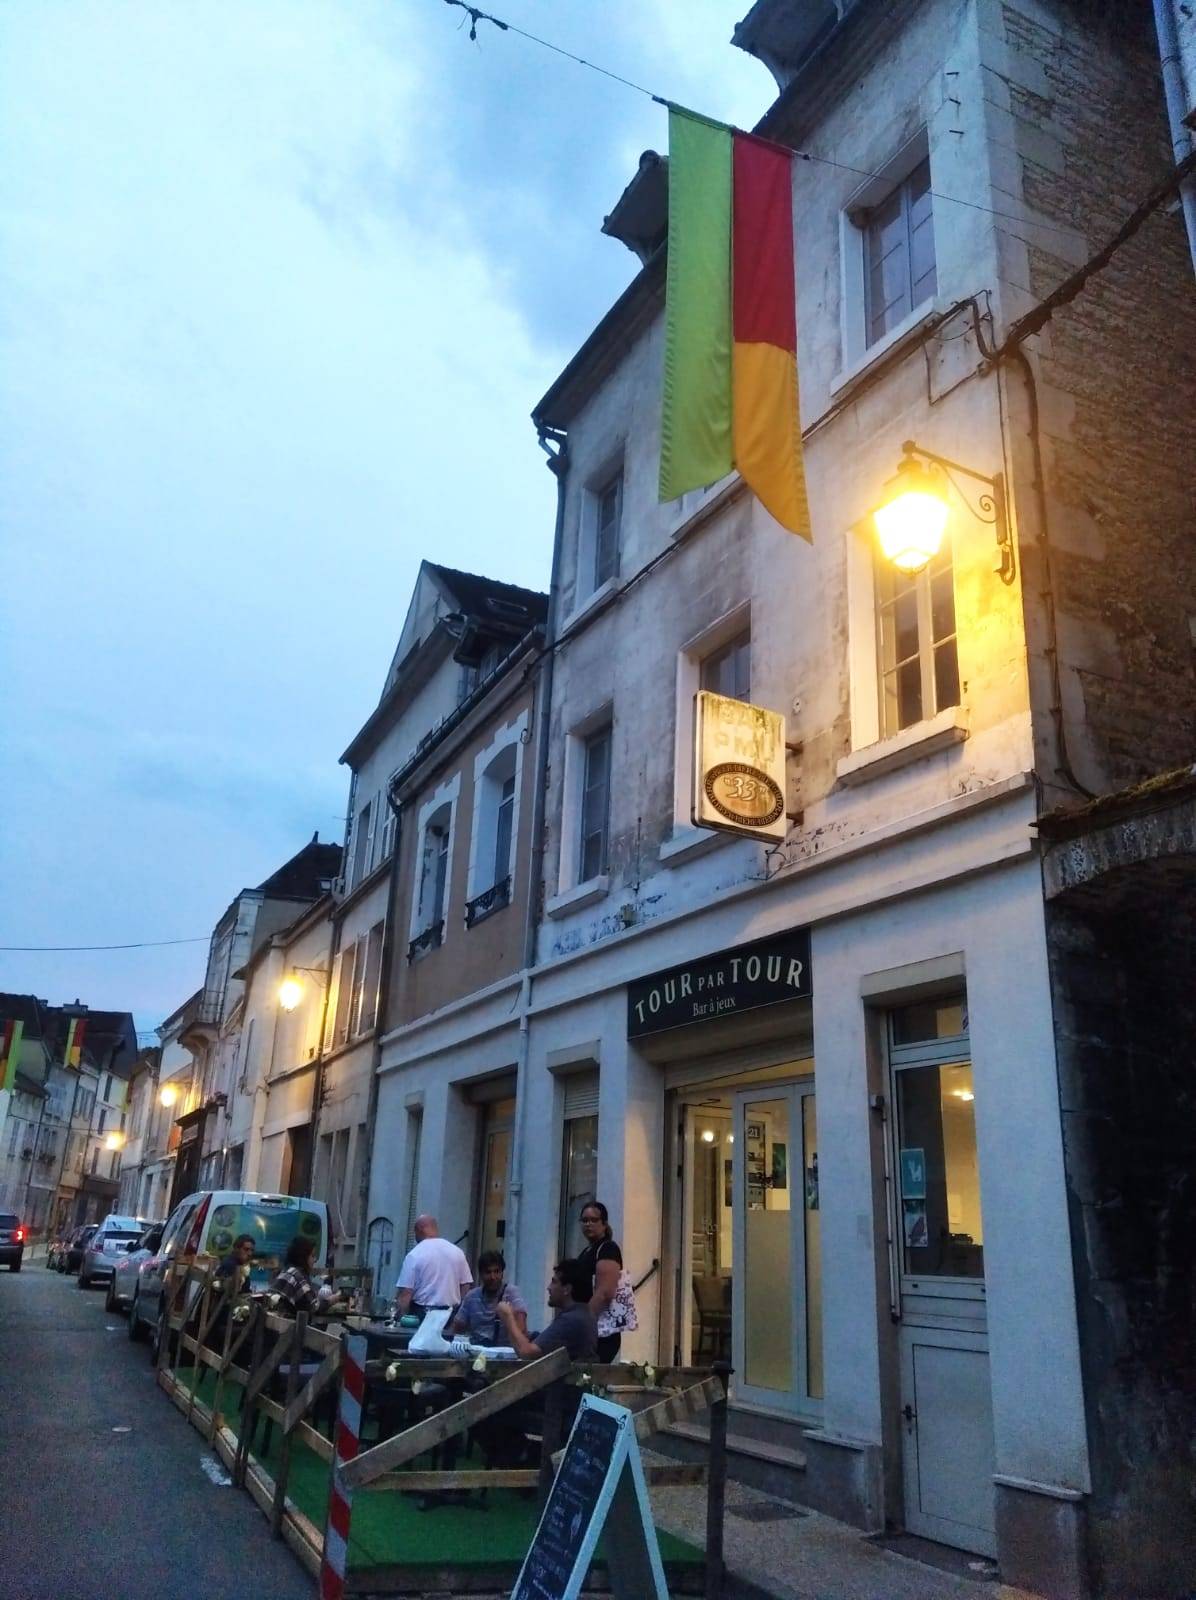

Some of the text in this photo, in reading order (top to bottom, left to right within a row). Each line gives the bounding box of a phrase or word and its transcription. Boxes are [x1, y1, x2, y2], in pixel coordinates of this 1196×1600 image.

[635, 955, 803, 1024] TOUR PAR TOUR
[693, 996, 736, 1017] Bar à jeux
